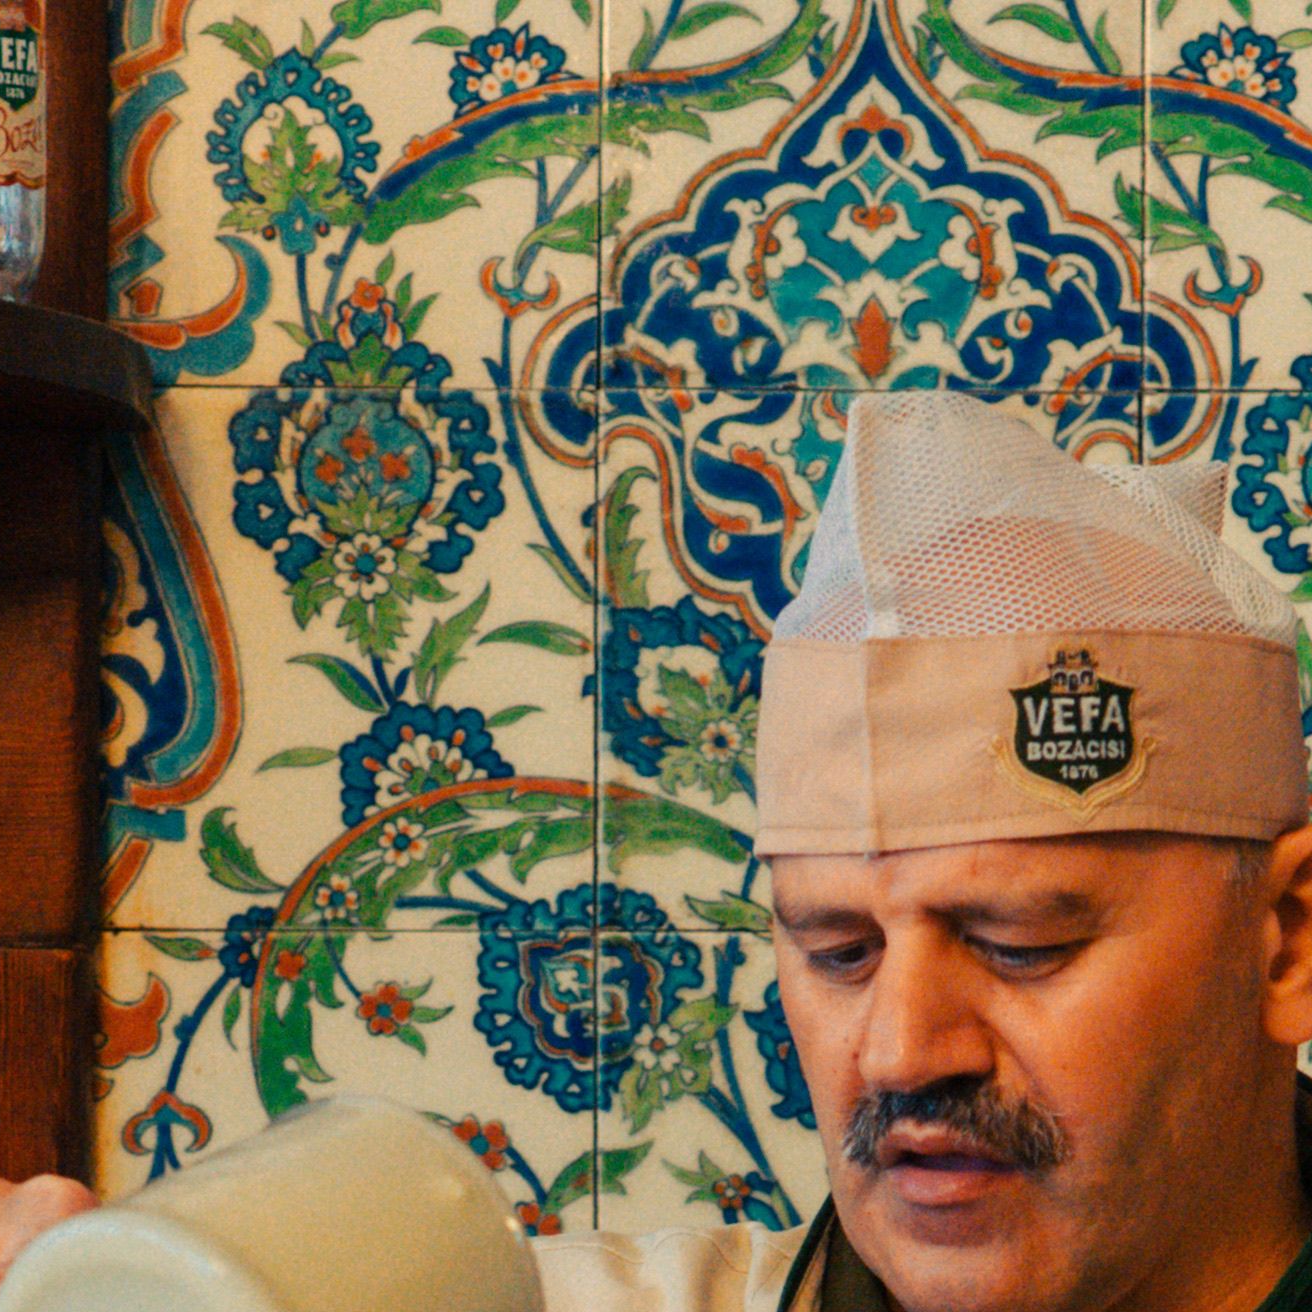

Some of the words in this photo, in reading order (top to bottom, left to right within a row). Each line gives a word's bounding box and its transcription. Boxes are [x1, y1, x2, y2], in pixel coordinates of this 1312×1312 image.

[1023, 695, 1126, 736] VEFA
[1026, 740, 1126, 761] BOZACISI
[1059, 765, 1099, 779] 1876
